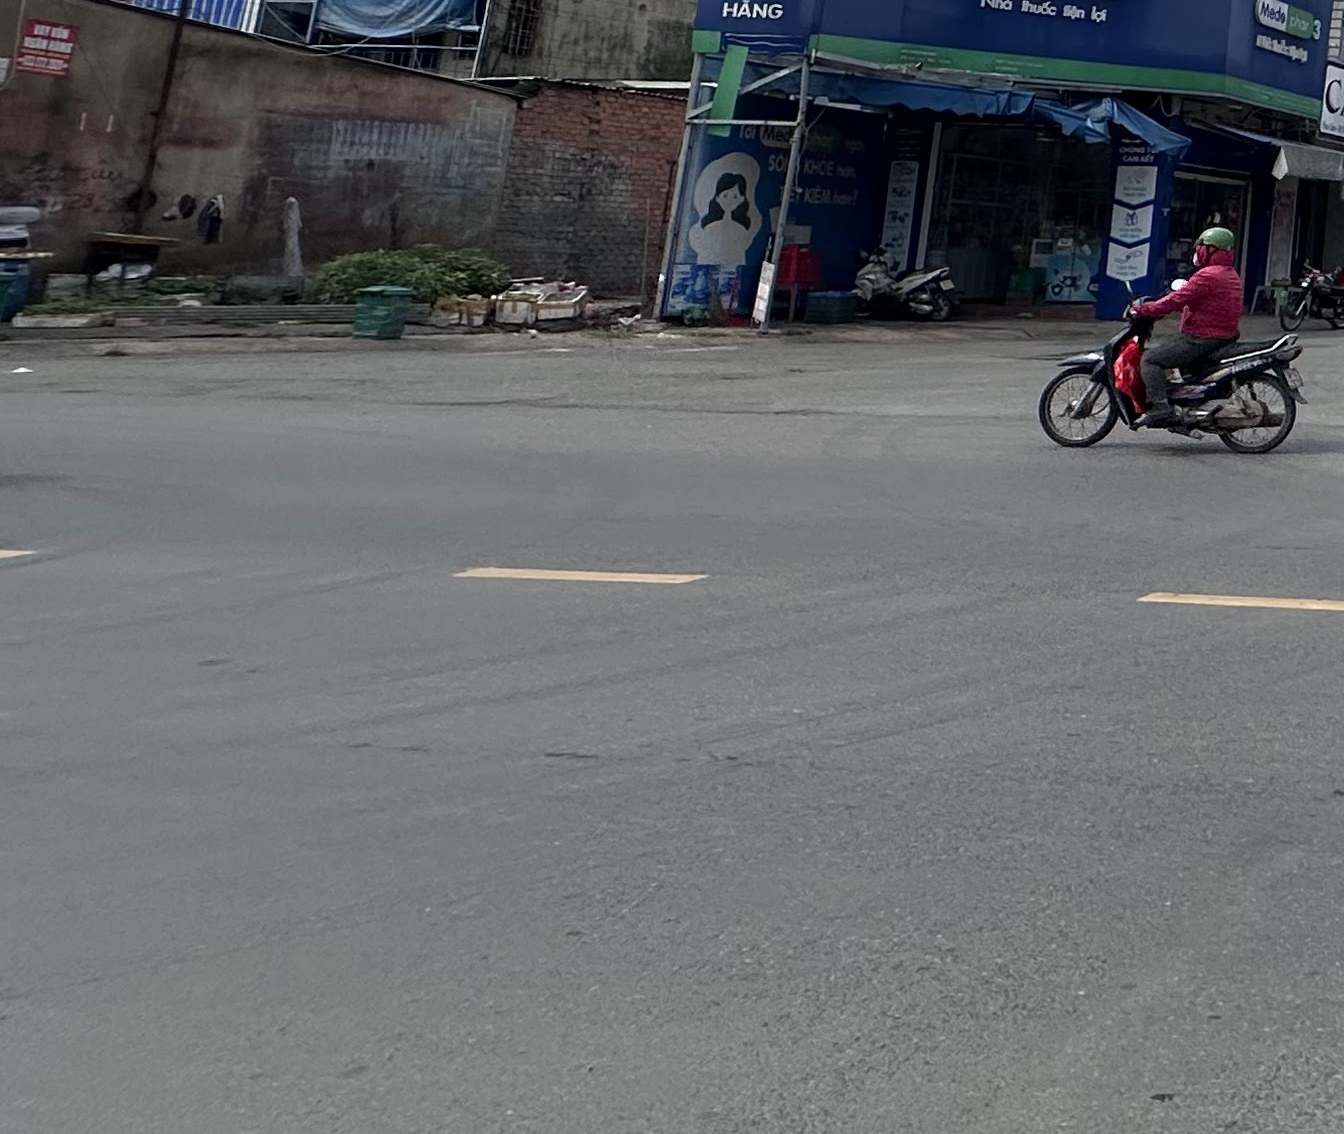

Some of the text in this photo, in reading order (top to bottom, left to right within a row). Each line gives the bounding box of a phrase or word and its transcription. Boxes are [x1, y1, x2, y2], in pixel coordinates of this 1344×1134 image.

[722, 0, 784, 19] HÃNG
[1021, 0, 1057, 16] thuốc
[1091, 6, 1107, 23] lợi
[1313, 19, 1322, 40] 3
